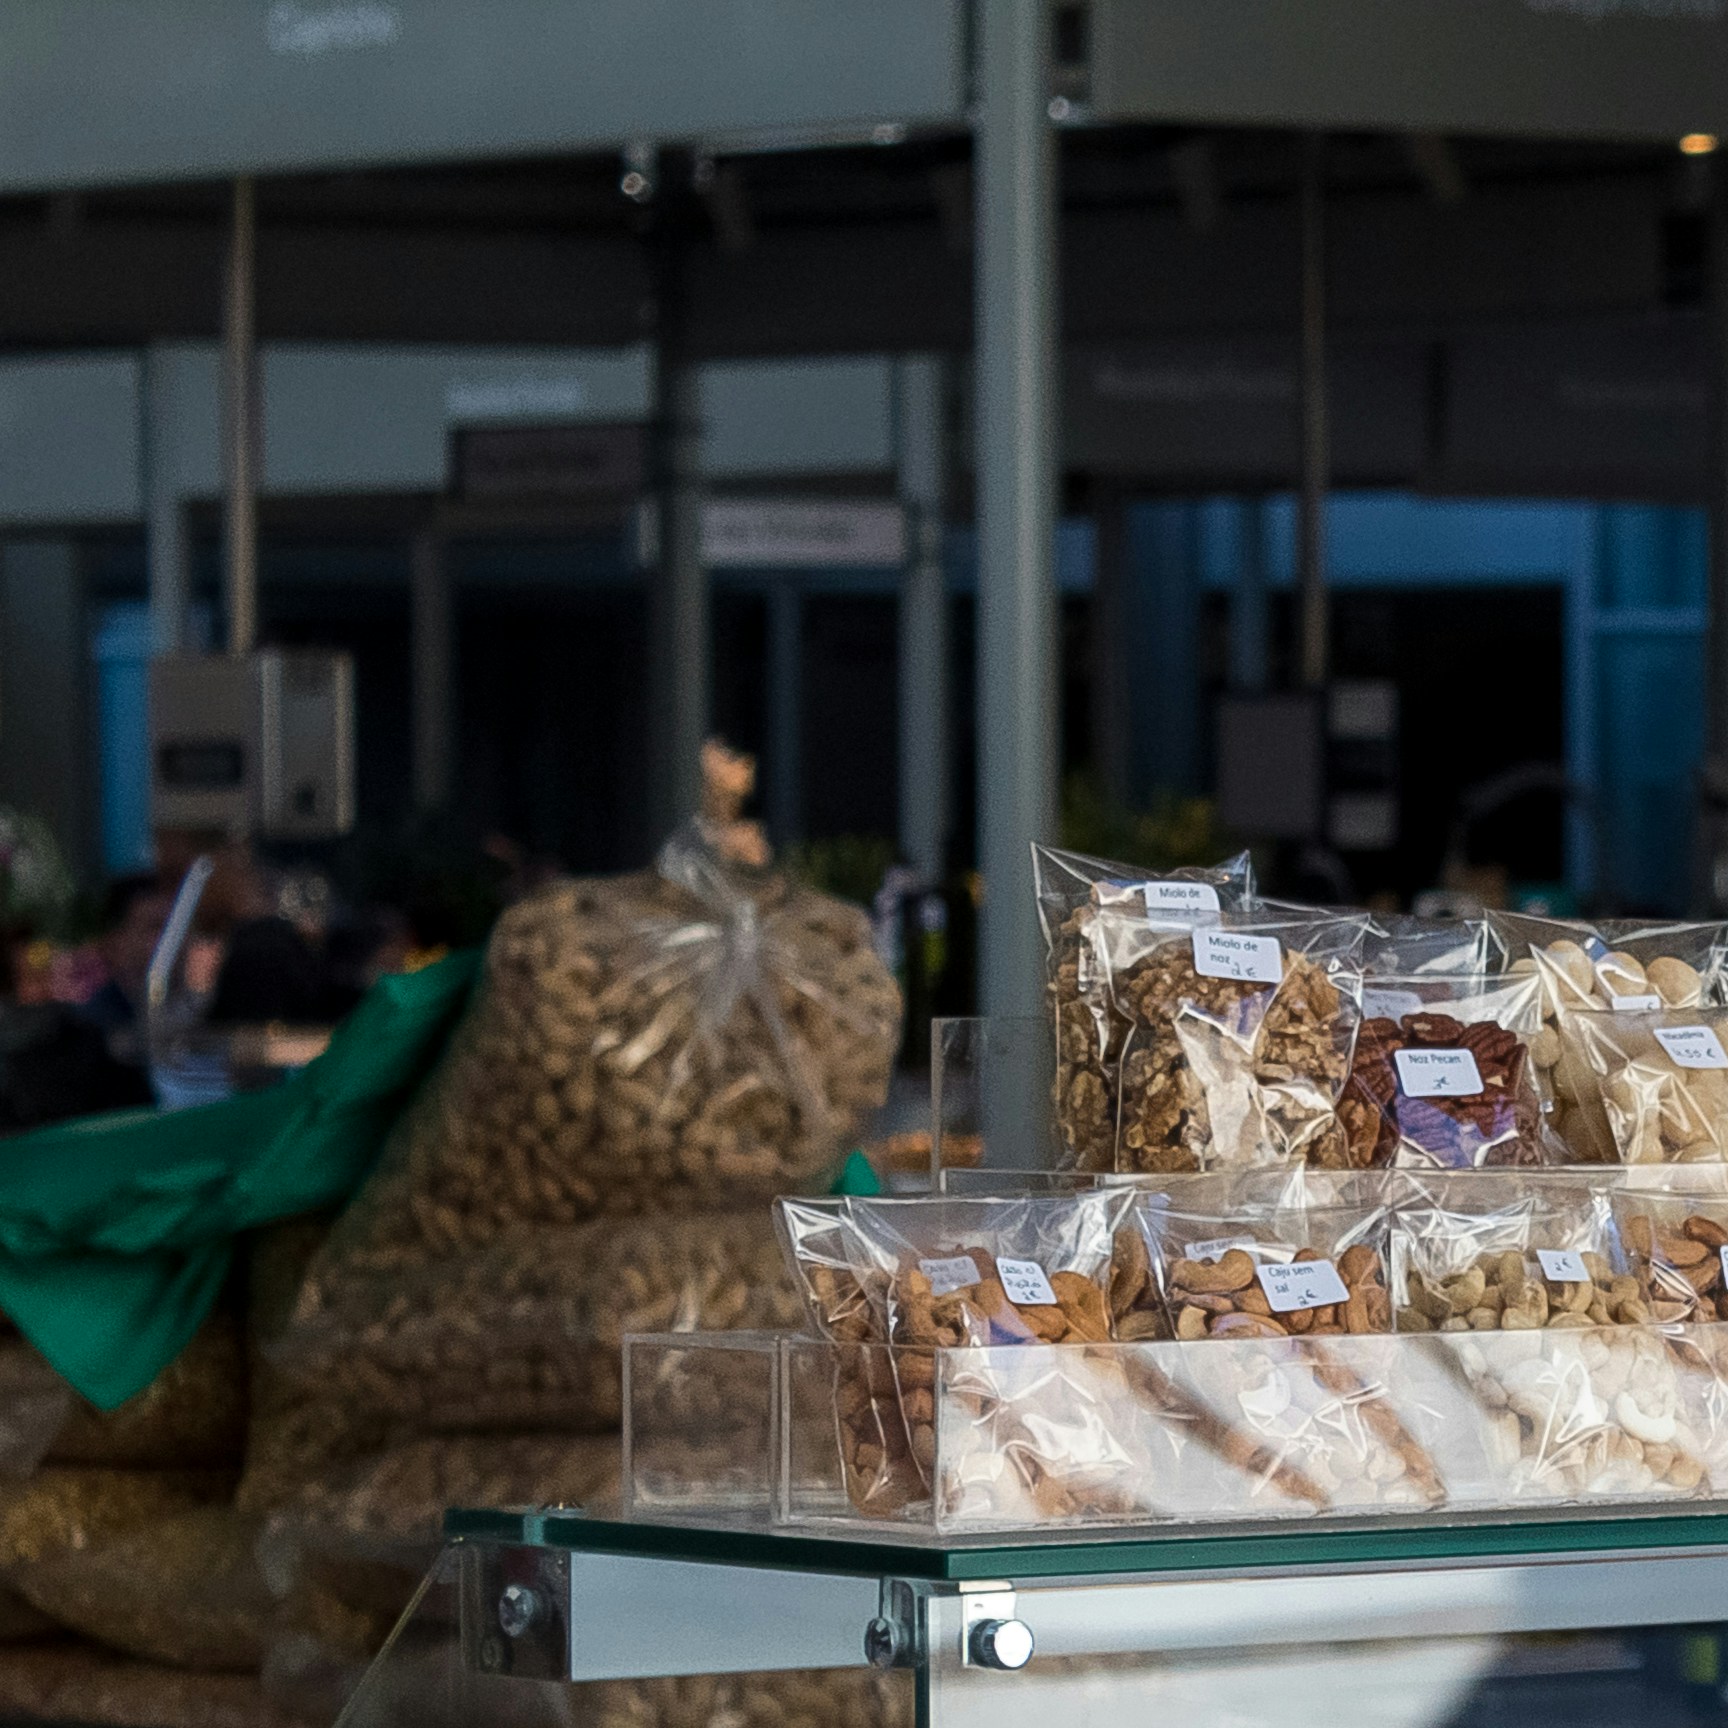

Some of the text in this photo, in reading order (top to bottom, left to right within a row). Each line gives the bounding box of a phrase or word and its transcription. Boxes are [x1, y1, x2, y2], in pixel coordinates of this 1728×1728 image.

[1208, 936, 1258, 952] Miolo de
[1209, 952, 1231, 965] noz
[1408, 1054, 1461, 1066] Noz Pecan
[1267, 1265, 1315, 1280] Caju sem
[1274, 1283, 1290, 1294] sal
